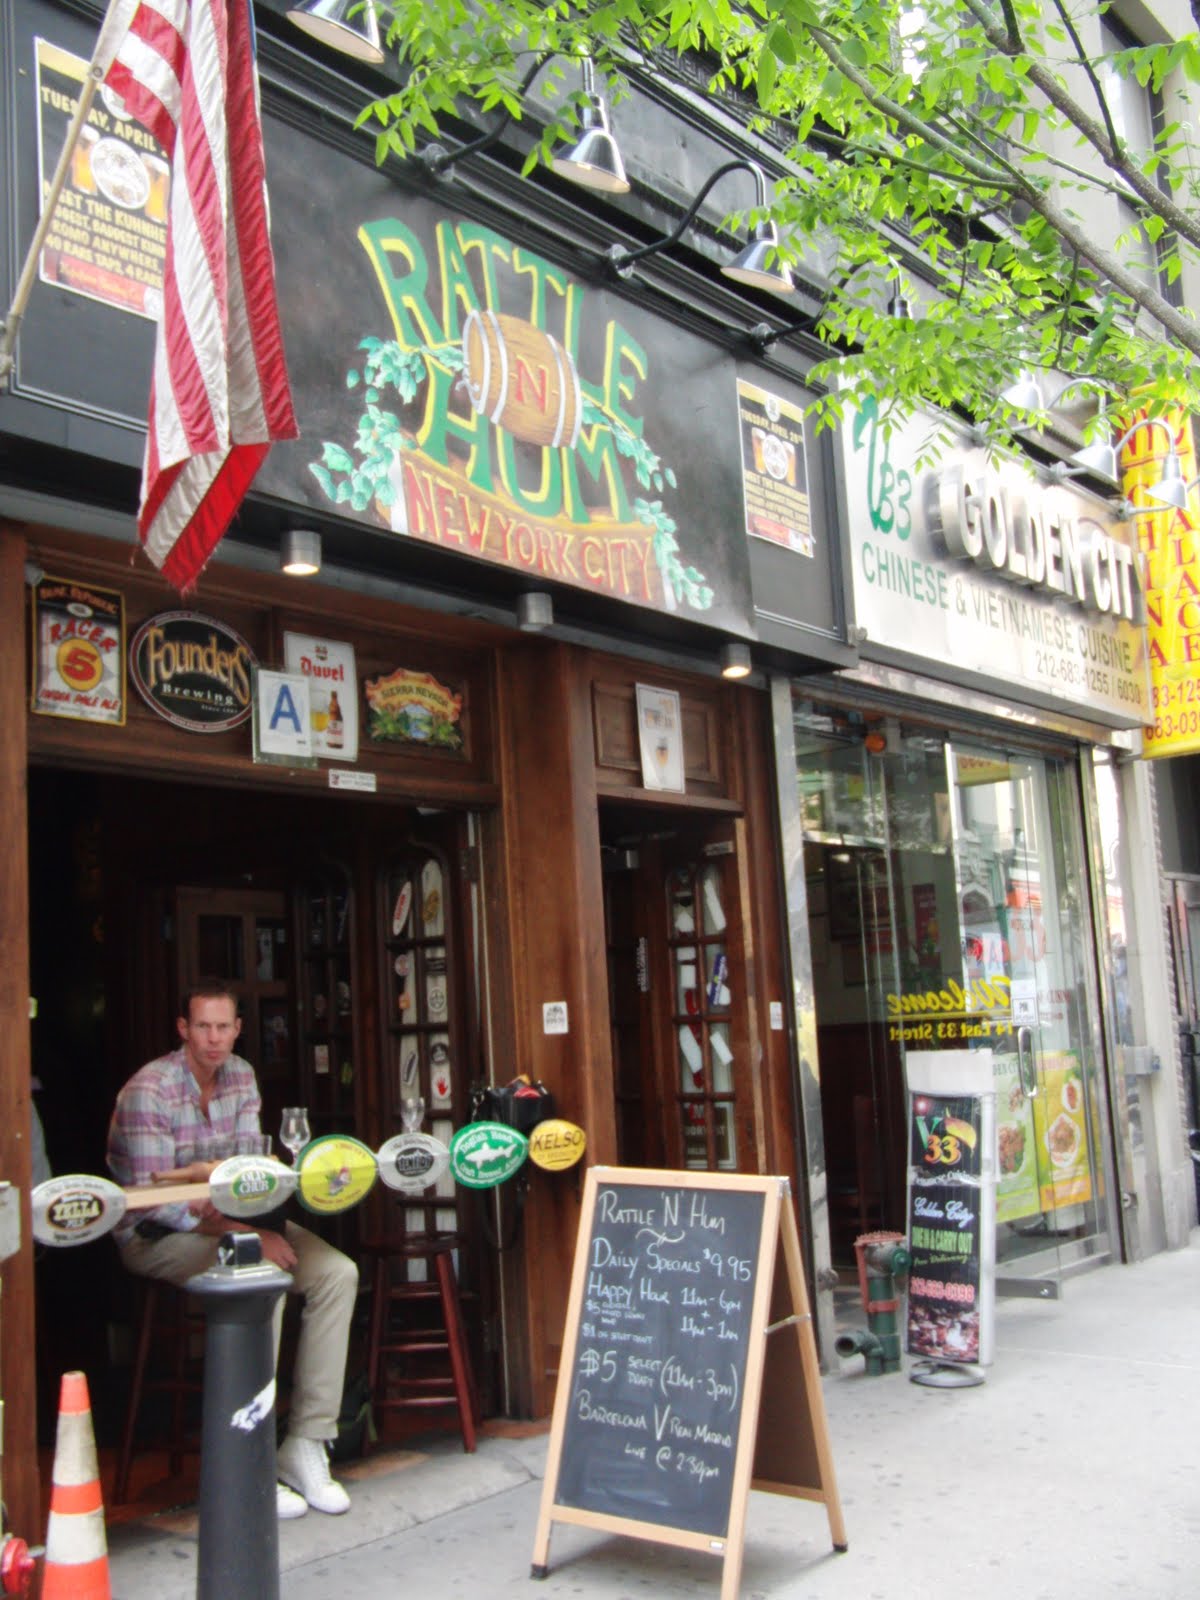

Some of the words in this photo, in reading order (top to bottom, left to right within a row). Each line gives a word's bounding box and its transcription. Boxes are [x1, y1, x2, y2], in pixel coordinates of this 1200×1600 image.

[41, 86, 111, 132] TUESAY,
[113, 121, 157, 153] APRIL
[85, 198, 113, 223] THE
[358, 217, 648, 439] RATTLE
[515, 354, 549, 414] N
[416, 353, 634, 524] HUM
[405, 460, 489, 552] NEW
[493, 512, 579, 579] YORK
[579, 533, 654, 600] CITY
[939, 464, 1085, 602] GOLDEN
[862, 541, 949, 609] CHINESE
[955, 577, 967, 617] &
[970, 583, 1075, 653] VIETNAMESE
[1078, 623, 1133, 675] CUISINE
[50, 618, 118, 654] RACER
[62, 647, 98, 682] 5
[300, 656, 345, 682] Duvel
[162, 683, 235, 706] Brewing
[269, 684, 303, 734] A
[533, 1130, 583, 1151] KELSO
[239, 1180, 269, 1194] CHUB
[241, 1170, 267, 1182] OLD
[945, 1201, 974, 1228] City
[957, 1232, 973, 1255] OUT
[580, 1347, 618, 1384] $5
[656, 1446, 672, 1472] @
